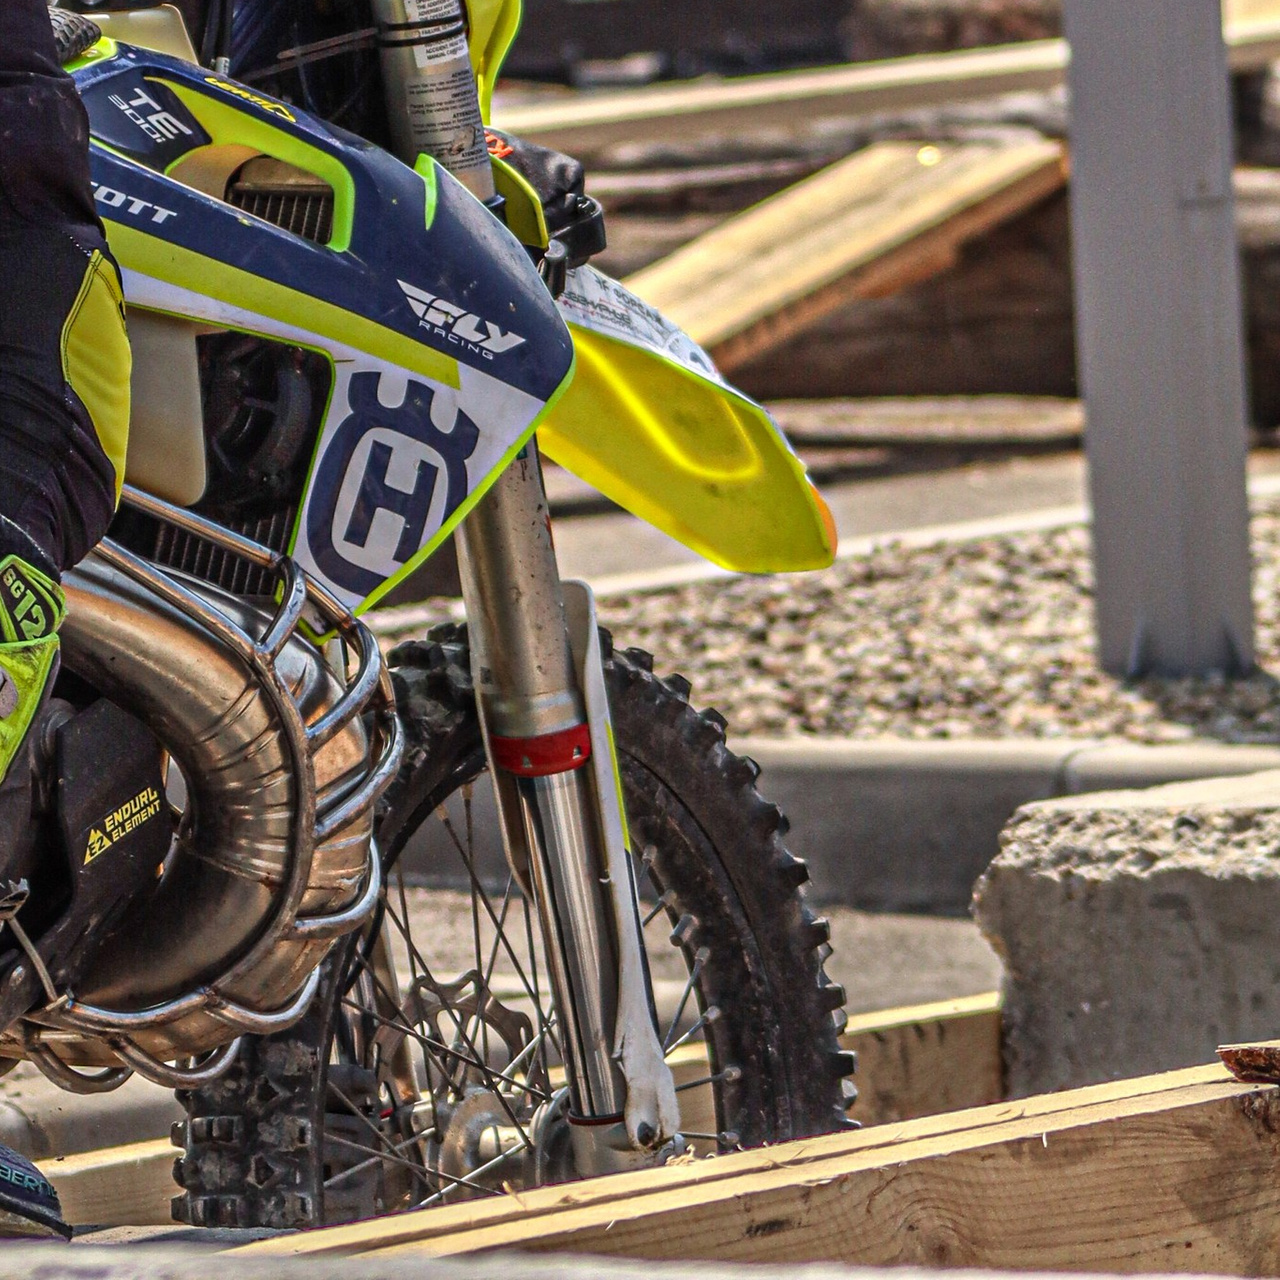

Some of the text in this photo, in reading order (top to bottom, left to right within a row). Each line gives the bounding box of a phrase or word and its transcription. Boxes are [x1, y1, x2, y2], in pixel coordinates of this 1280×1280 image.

[128, 87, 193, 140] TE
[90, 181, 179, 224] OTT
[410, 290, 526, 353] FLY
[418, 320, 494, 361] RACING
[111, 798, 162, 843] ELEMENT
